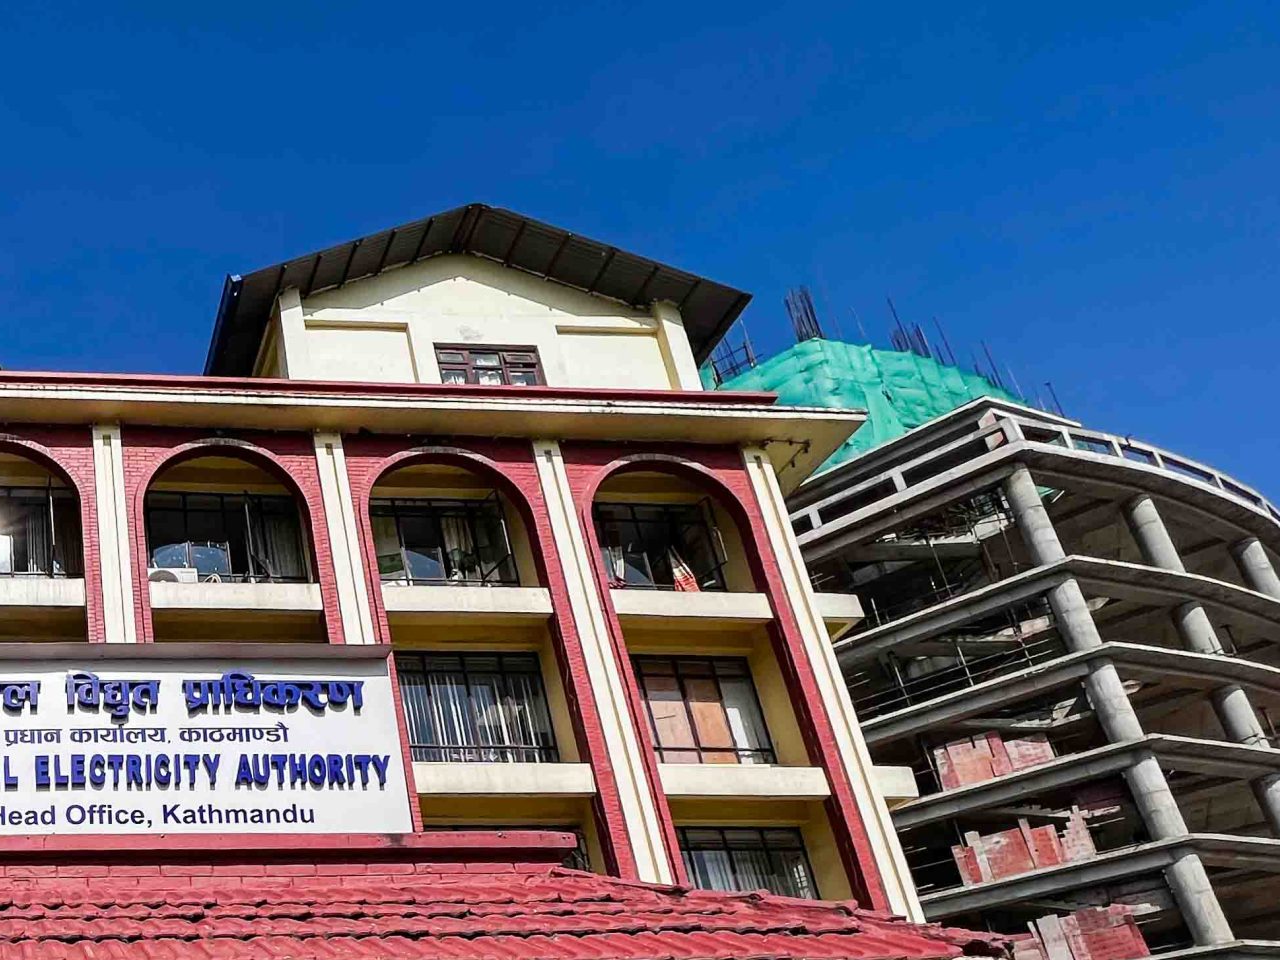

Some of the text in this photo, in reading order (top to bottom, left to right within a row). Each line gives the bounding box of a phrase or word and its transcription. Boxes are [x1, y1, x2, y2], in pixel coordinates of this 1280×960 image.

[65, 671, 161, 719] विद्युत
[182, 671, 365, 713] प्राधिकरण
[4, 728, 63, 746] प्रधान
[179, 722, 289, 744] काठमाण्डौ
[35, 753, 221, 788] ELECTRICITY
[235, 753, 391, 788] AUTHORITY
[66, 804, 153, 829] Office,
[163, 804, 315, 826] Kathmandu
